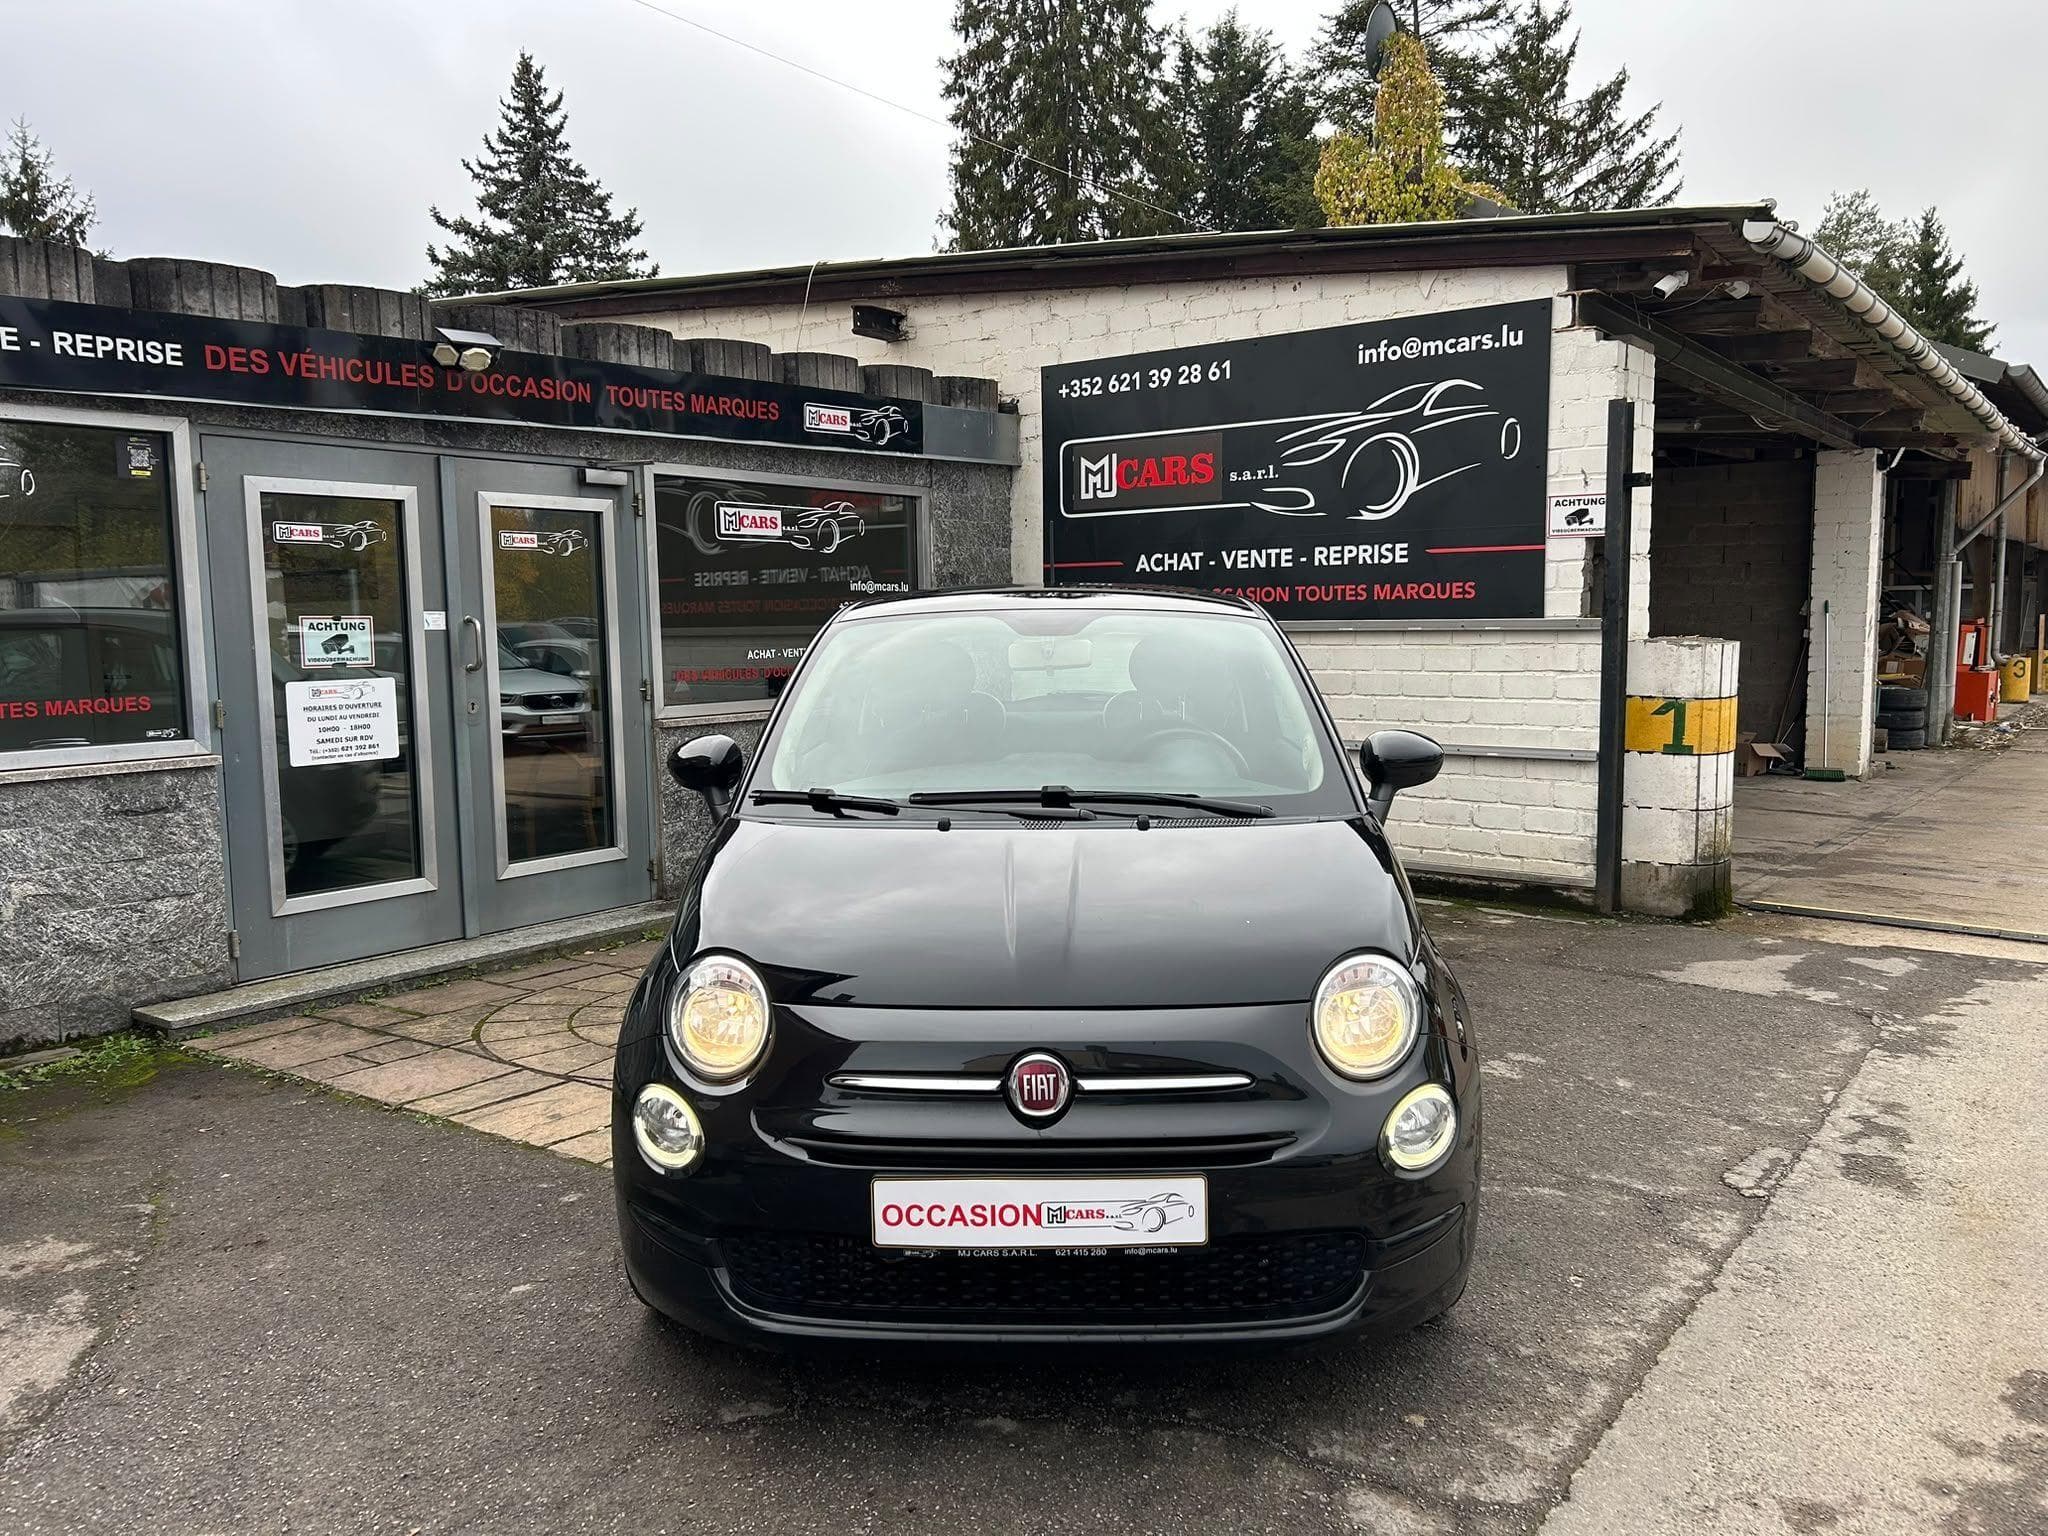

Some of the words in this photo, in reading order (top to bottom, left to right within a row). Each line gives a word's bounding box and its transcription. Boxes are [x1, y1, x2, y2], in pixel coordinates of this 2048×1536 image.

[53, 331, 184, 367] REPRISE
[1358, 324, 1523, 364] info@mcars.lu
[204, 344, 270, 374] DES
[278, 348, 434, 388] VÉHICULES
[446, 370, 591, 403] D'OCCASION
[606, 384, 685, 411] TOUTES
[691, 396, 779, 421] MARQUES
[1058, 377, 1102, 398] +352
[1108, 372, 1141, 393] 621
[1148, 367, 1172, 388] 39
[1178, 363, 1202, 385] 28
[1208, 360, 1232, 380] 61
[1229, 465, 1279, 482] s.a.r.l.
[1554, 498, 1606, 507] ACHTUNG
[1135, 552, 1204, 573] ACHAT
[1221, 548, 1293, 569] VENTE
[1314, 543, 1409, 566] REPRISE
[849, 580, 909, 594] info@mcars.lu
[1295, 584, 1367, 601] TOUTES
[1373, 582, 1476, 600] MARQUES
[308, 622, 366, 631] ACHTUNG
[747, 649, 776, 660] ACHAT
[2013, 660, 2025, 678] 3
[45, 696, 152, 717] MARQUES
[303, 704, 337, 712] HORAIRES
[339, 702, 382, 711] D'OUVERTURE
[349, 712, 380, 720] VENDREDI
[1650, 700, 1694, 754] 1
[345, 735, 358, 743] SUR
[1023, 1074, 1056, 1101] FIAT
[882, 1203, 1042, 1227] OCCASION
[958, 1249, 970, 1257] MJ
[973, 1249, 999, 1257] CARS
[1001, 1249, 1038, 1257] S.A.R.L.
[1055, 1248, 1070, 1257] 621
[1073, 1248, 1088, 1257] 415
